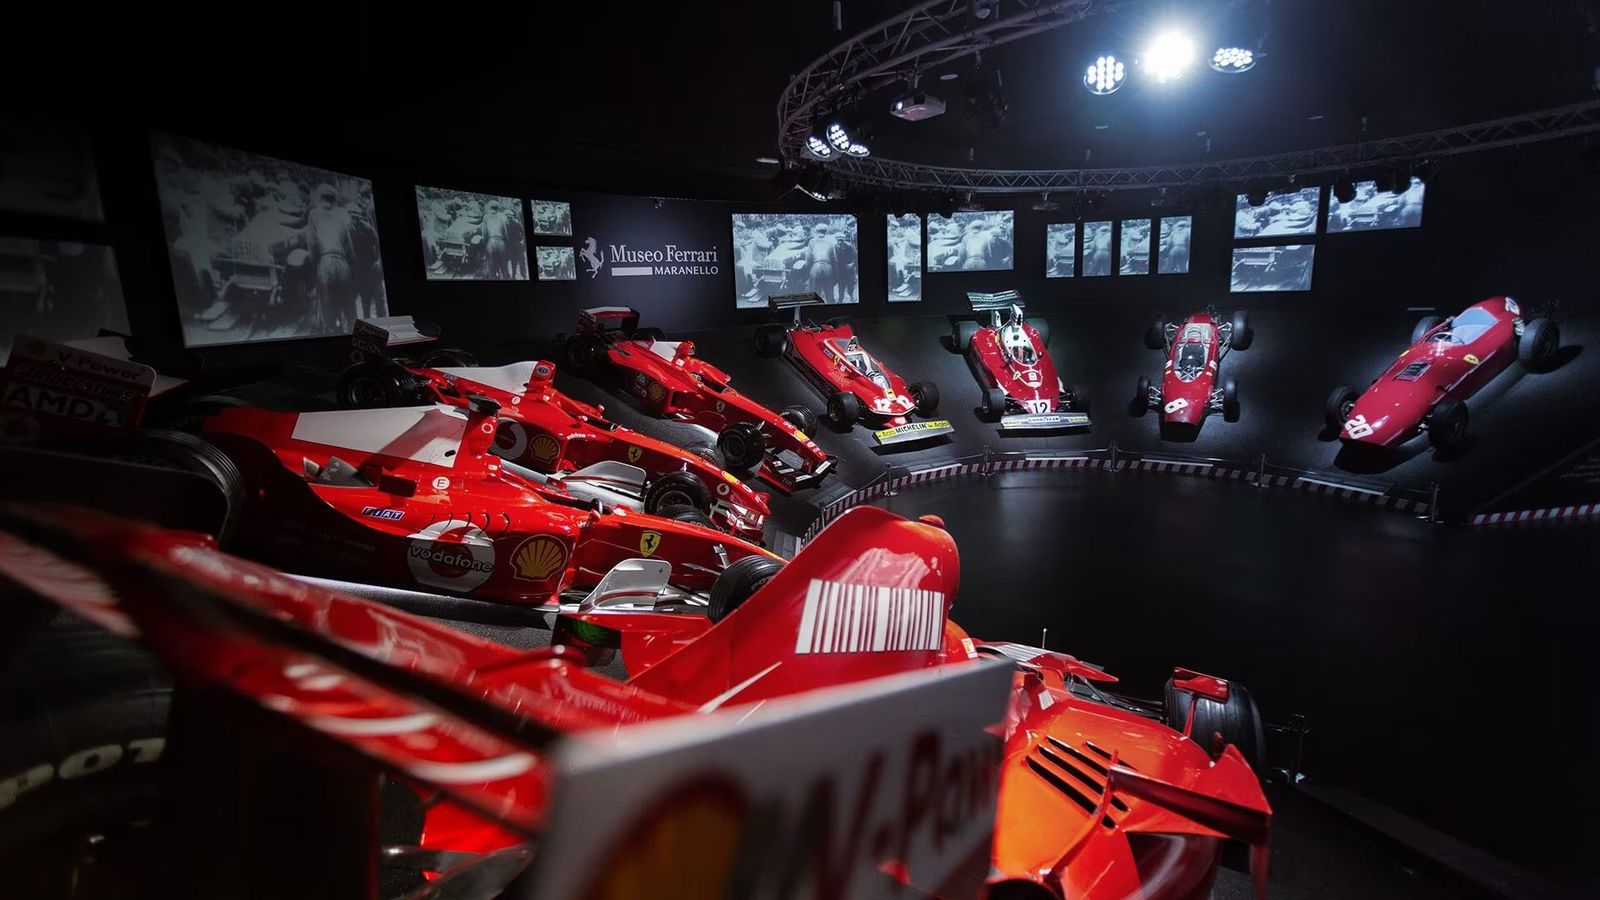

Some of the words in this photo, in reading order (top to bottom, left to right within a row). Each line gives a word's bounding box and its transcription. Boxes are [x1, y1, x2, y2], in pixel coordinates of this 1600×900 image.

[609, 244, 663, 263] Museo
[665, 244, 718, 263] Ferrari
[654, 266, 719, 275] MARANELLO
[6, 386, 94, 418] AMD
[873, 396, 891, 412] 12
[1033, 402, 1048, 413] 12
[1164, 397, 1189, 413] 8
[895, 422, 927, 433] MICHELIN
[1345, 414, 1374, 439] 20
[364, 507, 403, 519] FIAT
[410, 543, 493, 573] vodafone
